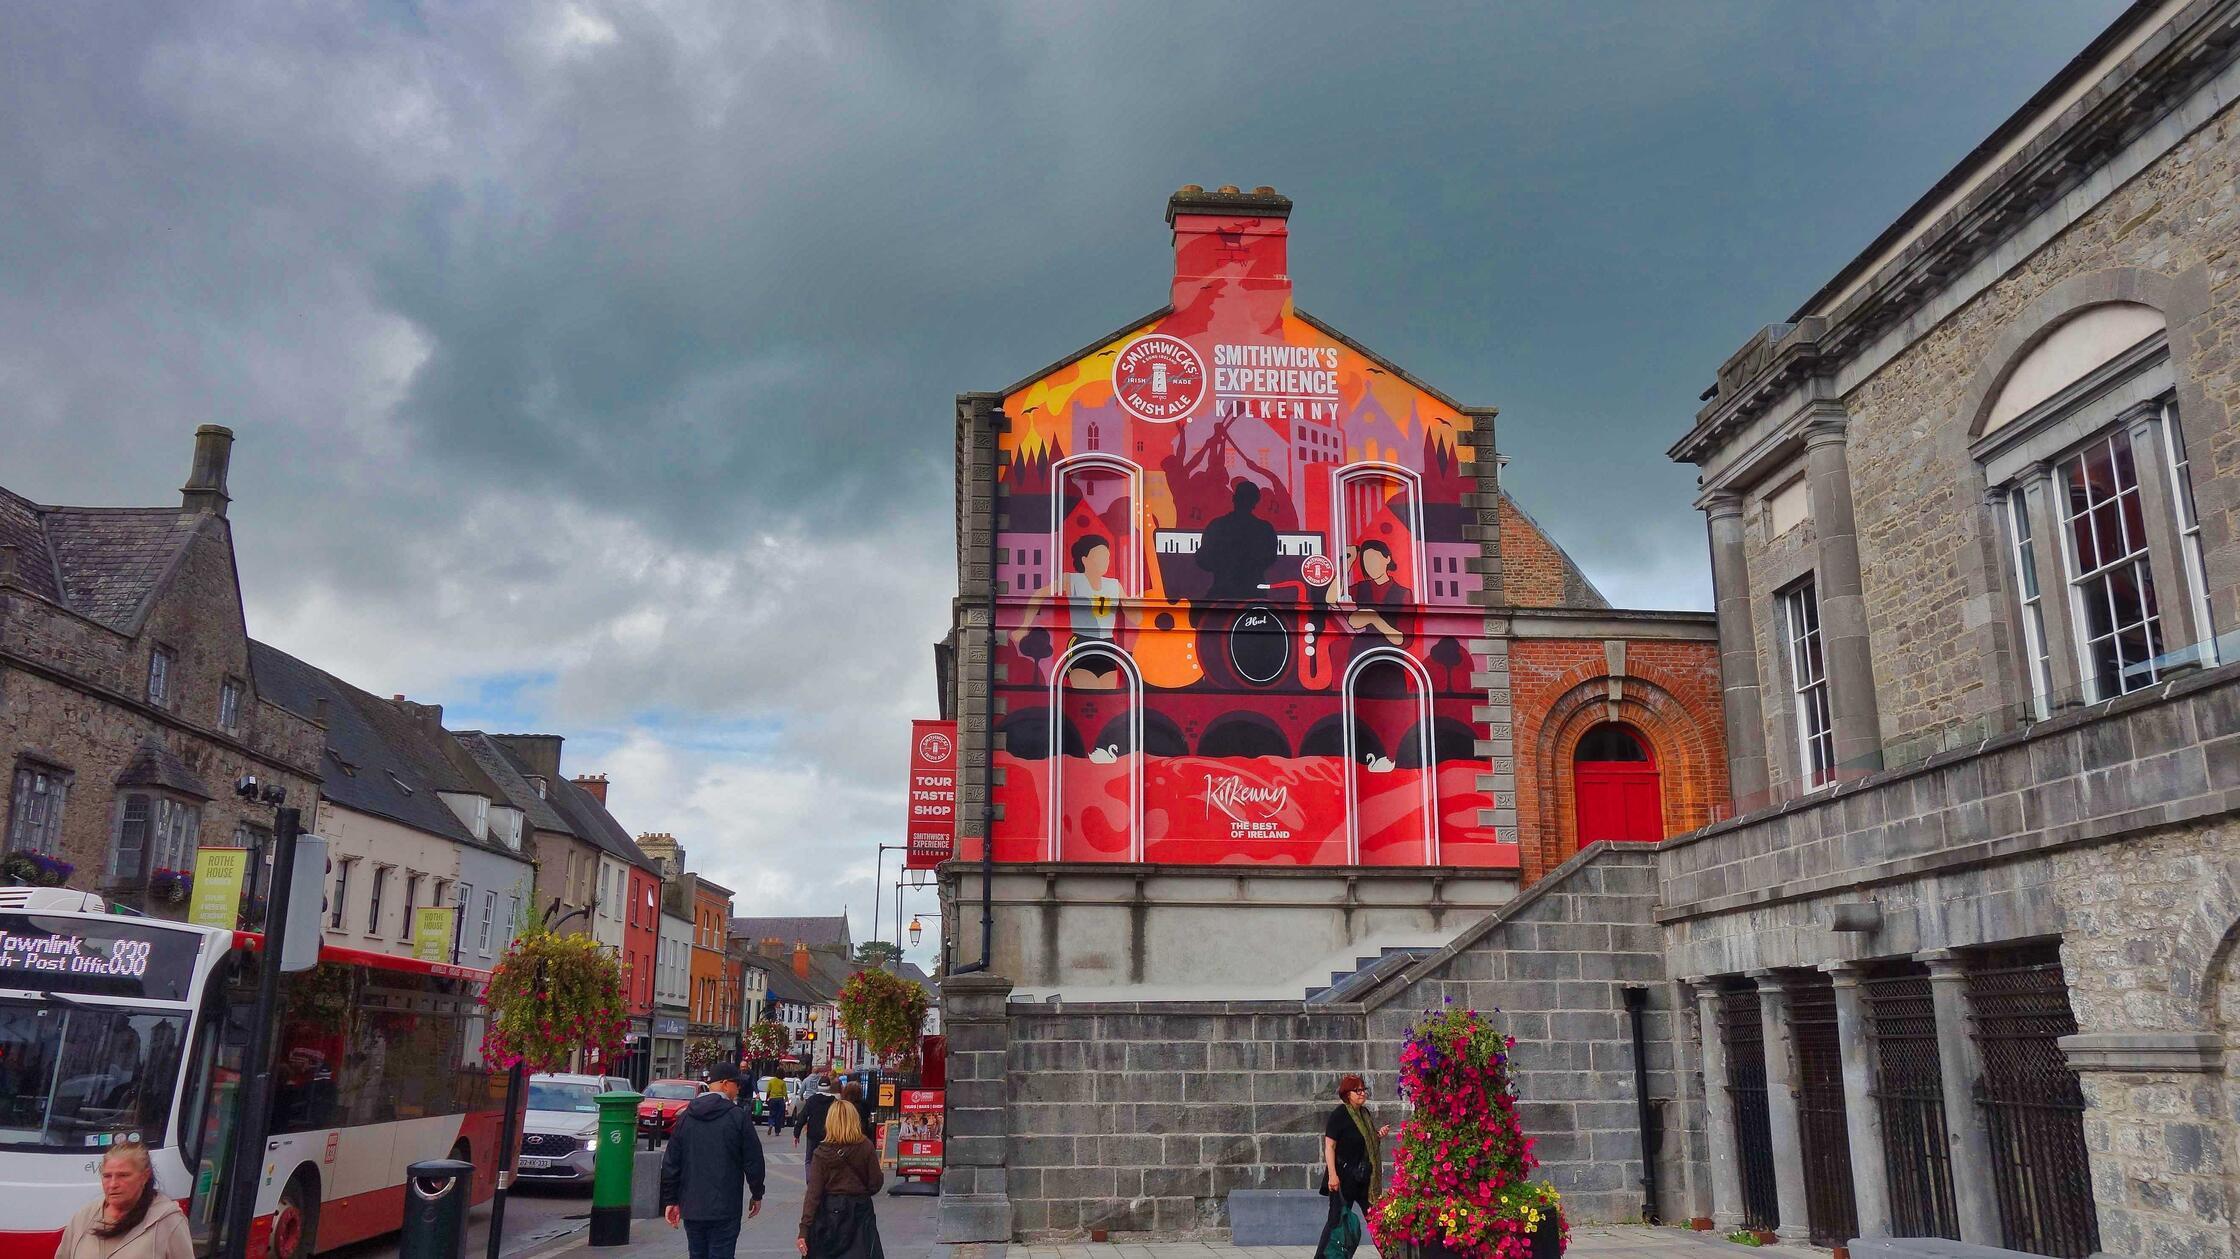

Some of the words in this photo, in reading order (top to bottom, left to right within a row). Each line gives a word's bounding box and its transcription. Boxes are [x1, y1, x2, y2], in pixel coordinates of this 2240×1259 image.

[1214, 344, 1338, 369] SMITHWICK'S
[1214, 367, 1339, 395] EXPERIENCE
[1127, 392, 1165, 416] IRISH
[1168, 394, 1192, 415] ALE
[1215, 399, 1339, 421] KILKENNY
[915, 776, 952, 787] TOUR
[912, 790, 954, 801] TASTE
[1203, 773, 1287, 823] Kilkenny
[914, 805, 951, 815] SHOP
[1230, 822, 1250, 830] THE
[1252, 822, 1278, 831] BEST
[913, 832, 950, 841] SMITHWICK'S
[1230, 830, 1245, 839] OF
[1247, 830, 1290, 839] IRELAND
[913, 840, 950, 849] EXPERIENCE
[912, 849, 949, 857] KILKENNY
[208, 855, 236, 867] ROTHE
[206, 867, 234, 878] HOUSE
[423, 921, 443, 930] HOUSE
[0, 930, 83, 956] Townlink
[24, 952, 66, 971] Post
[108, 938, 150, 976] 838
